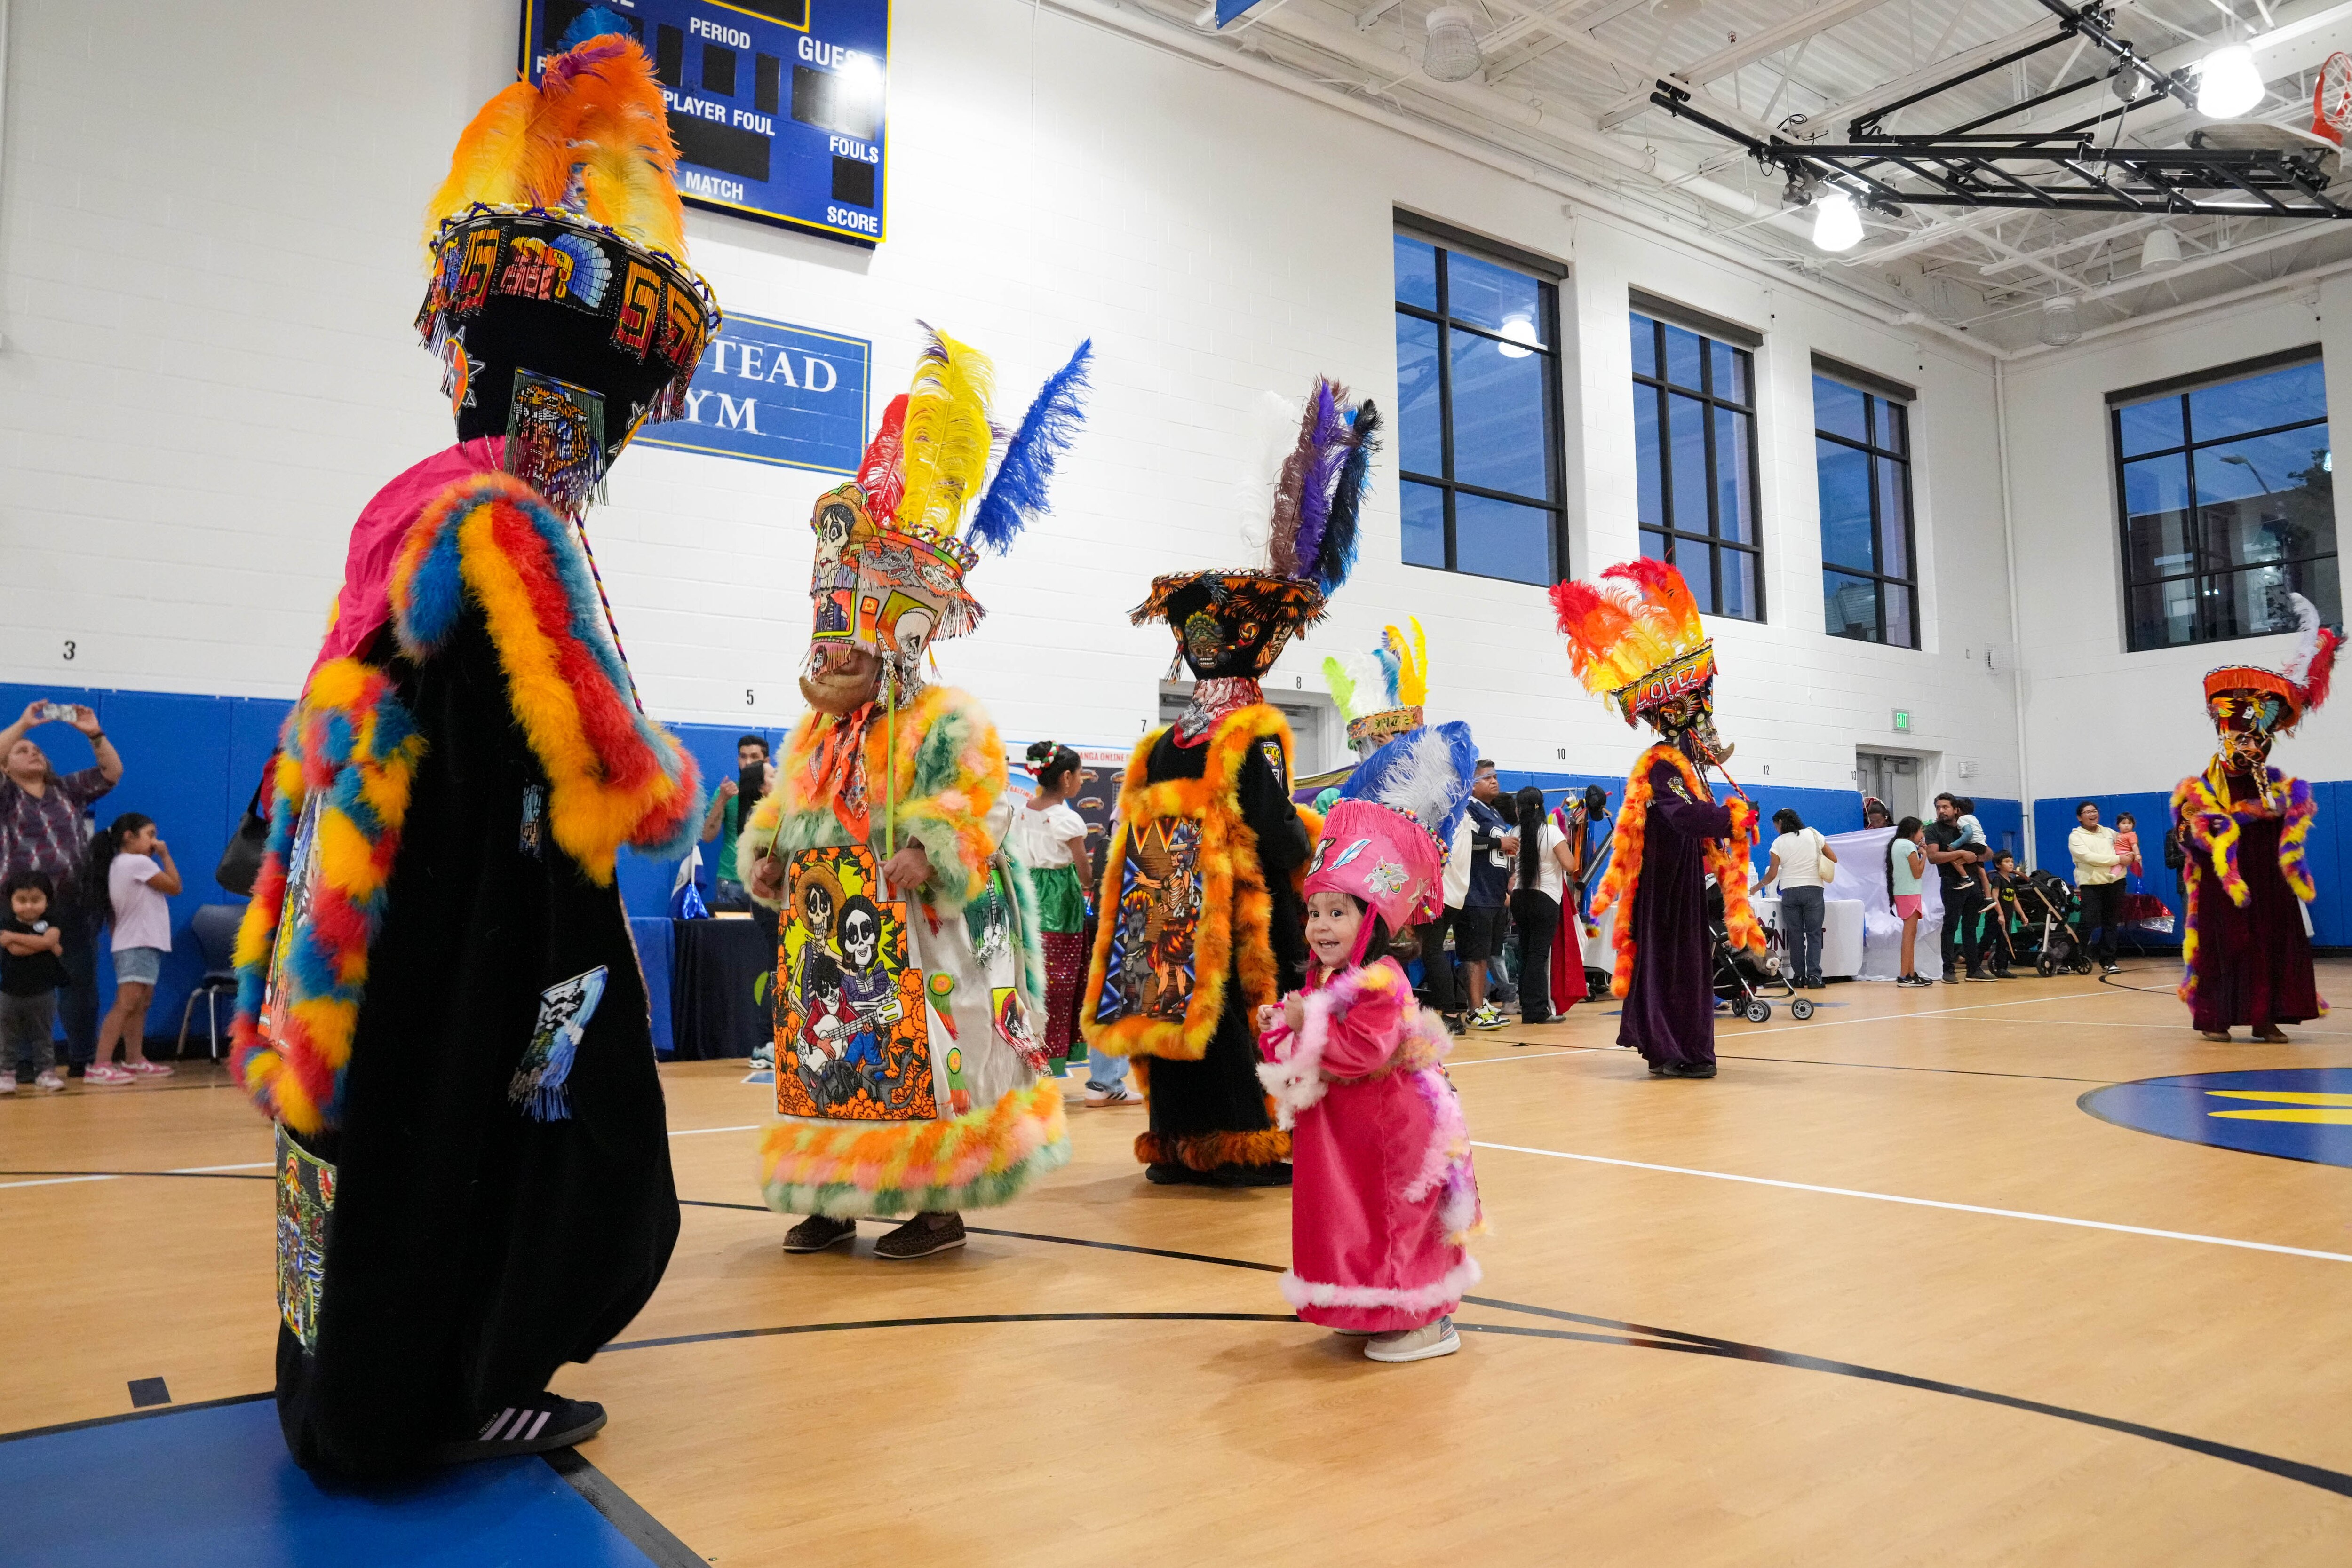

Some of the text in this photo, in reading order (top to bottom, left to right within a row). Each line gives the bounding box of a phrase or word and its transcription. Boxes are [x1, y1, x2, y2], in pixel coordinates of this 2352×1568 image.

[690, 17, 750, 49] PERIOD
[662, 90, 775, 136] PLAYER FOUL
[829, 136, 879, 163] FOULS
[686, 171, 743, 200] MATCH
[827, 206, 878, 233] SCORE
[63, 641, 75, 660] 3
[1296, 676, 1301, 689] 8
[1636, 664, 1698, 708] LOPEZ
[747, 689, 754, 705] 5
[1141, 720, 1147, 732] 7
[1897, 713, 1907, 728] EXIT
[1100, 752, 1124, 762] ONLINE
[1557, 748, 1565, 760] 10
[1764, 765, 1770, 775] 12
[1851, 771, 1857, 781] 13
